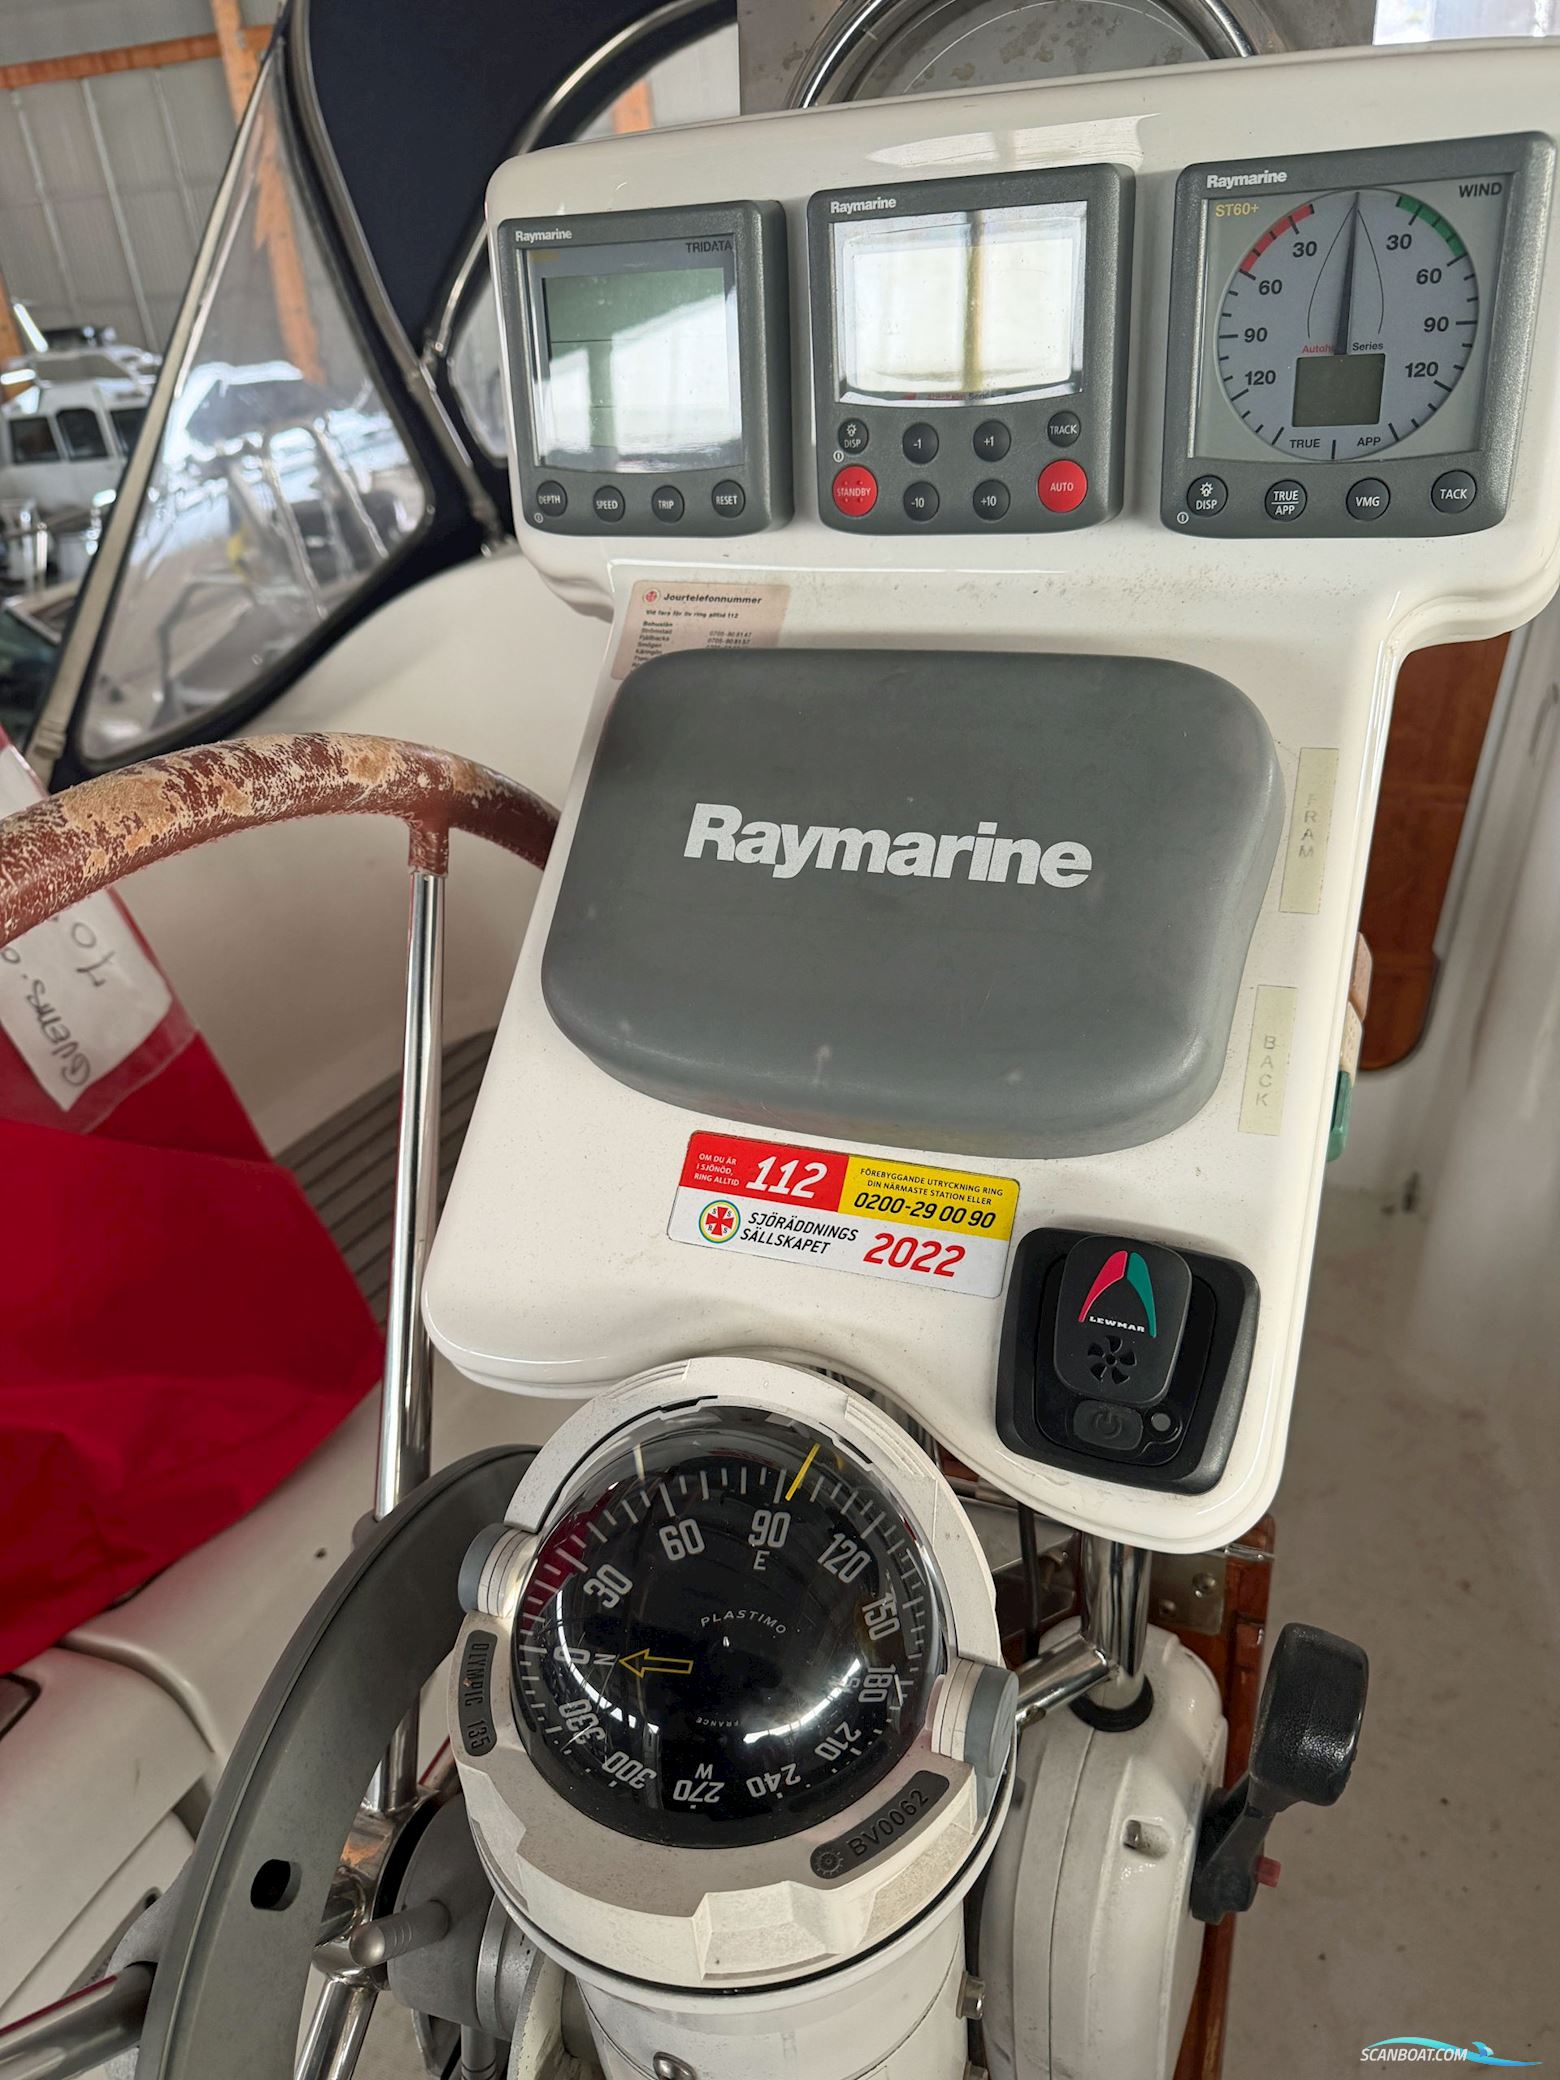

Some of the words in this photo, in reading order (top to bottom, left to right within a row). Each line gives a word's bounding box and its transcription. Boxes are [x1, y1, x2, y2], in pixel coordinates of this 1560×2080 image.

[1206, 169, 1287, 189] Raymarine
[1458, 182, 1503, 199] WIND
[830, 197, 897, 215] Raymarine
[1215, 202, 1260, 218] ST60+
[515, 228, 573, 244] Raymarine
[1386, 233, 1413, 250] 30
[686, 239, 733, 255] TRIDATA
[1292, 240, 1318, 258] 30
[1416, 267, 1443, 285] 60
[1258, 278, 1283, 296] 60
[1423, 316, 1450, 332] 90
[1243, 326, 1268, 342] 90
[1352, 341, 1384, 352] Series
[1244, 369, 1277, 386] 120
[1405, 361, 1439, 378] 120
[1050, 424, 1078, 436] TRACK
[844, 438, 861, 449] DISP
[913, 439, 922, 450] -1
[984, 436, 994, 448] +1
[1290, 437, 1321, 450] TRUE
[1356, 435, 1382, 449] APP
[837, 486, 871, 498] STANDBY
[1050, 481, 1074, 492] AUTO
[1440, 487, 1468, 501] TACK
[538, 495, 561, 505] DEPTH
[716, 495, 738, 505] RESET
[911, 497, 925, 509] -10
[981, 495, 997, 507] +10
[1273, 489, 1299, 502] TRUE
[1355, 495, 1381, 508] VMG
[596, 500, 618, 510] SPEED
[658, 500, 674, 510] TRIP
[1195, 498, 1218, 511] DISP
[1275, 503, 1295, 517] APP
[664, 593, 762, 604] Jourtelefonnummer
[683, 802, 1093, 889] Raymarine
[1255, 1034, 1277, 1107] BACK
[699, 1153, 712, 1161] OM
[713, 1155, 725, 1163] DU
[726, 1157, 737, 1165] ÄR
[701, 1163, 733, 1176] SJÖNÖD,
[745, 1155, 829, 1199] 112
[694, 1172, 713, 1182] RING
[714, 1176, 740, 1187] ALLTID
[860, 1168, 925, 1185] FÖREBYGGANDE
[927, 1178, 980, 1193] UTRYCKNING
[982, 1186, 1004, 1197] RING
[867, 1179, 881, 1189] DIN
[883, 1181, 928, 1196] NÄRMASTE
[930, 1189, 965, 1201] STATION
[967, 1195, 992, 1206] ELLER
[854, 1192, 937, 1219] 0200-29
[939, 1205, 967, 1224] 00
[968, 1210, 997, 1229] 90
[748, 1211, 859, 1242] SJÖRÄDDNINGS
[740, 1228, 831, 1255] SÄLLSKAPET
[862, 1232, 967, 1278] 2022
[1089, 1315, 1145, 1333] LEWMAR
[748, 1509, 791, 1548] 90
[658, 1518, 706, 1561] 60
[753, 1550, 770, 1571] E
[817, 1532, 872, 1584] 120
[582, 1563, 634, 1609] 30
[701, 1609, 787, 1634] PLASTIMO
[861, 1592, 900, 1641] 150
[553, 1646, 591, 1665] 0
[593, 1653, 617, 1666] N
[464, 1643, 490, 1707] OLYMPIC
[858, 1664, 896, 1703] 180
[558, 1698, 606, 1745] 330
[696, 1716, 739, 1727] FRANCE
[467, 1720, 491, 1750] 135
[814, 1721, 862, 1762] 210
[601, 1751, 657, 1790] 300
[695, 1763, 714, 1780] W
[745, 1763, 801, 1798] 240
[672, 1779, 725, 1803] 270
[846, 1789, 929, 1857] BV0062
